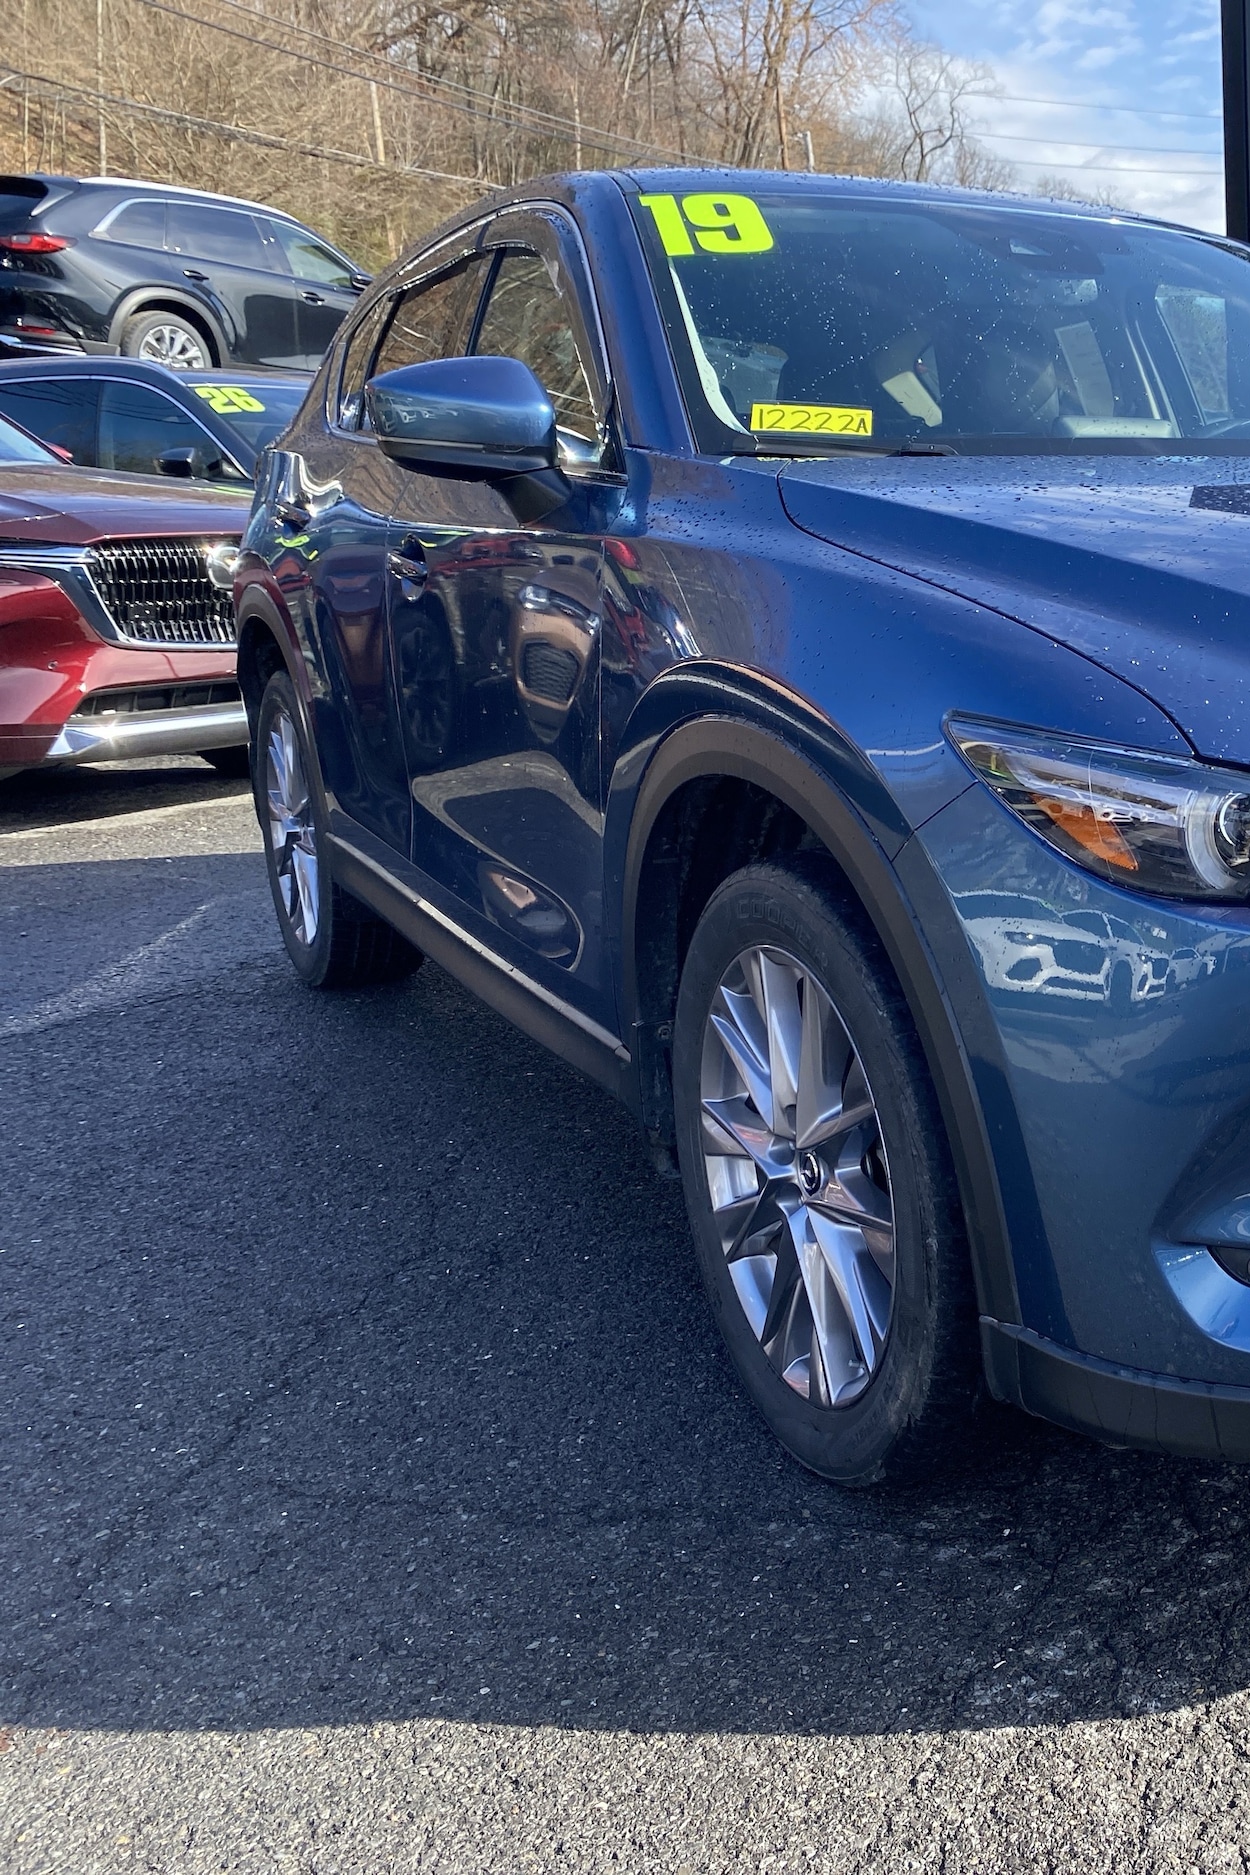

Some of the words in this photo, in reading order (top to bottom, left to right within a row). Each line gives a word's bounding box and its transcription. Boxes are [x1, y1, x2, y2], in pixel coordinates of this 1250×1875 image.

[638, 193, 774, 257] 19
[194, 386, 266, 414] 26
[758, 407, 869, 434] 12222A
